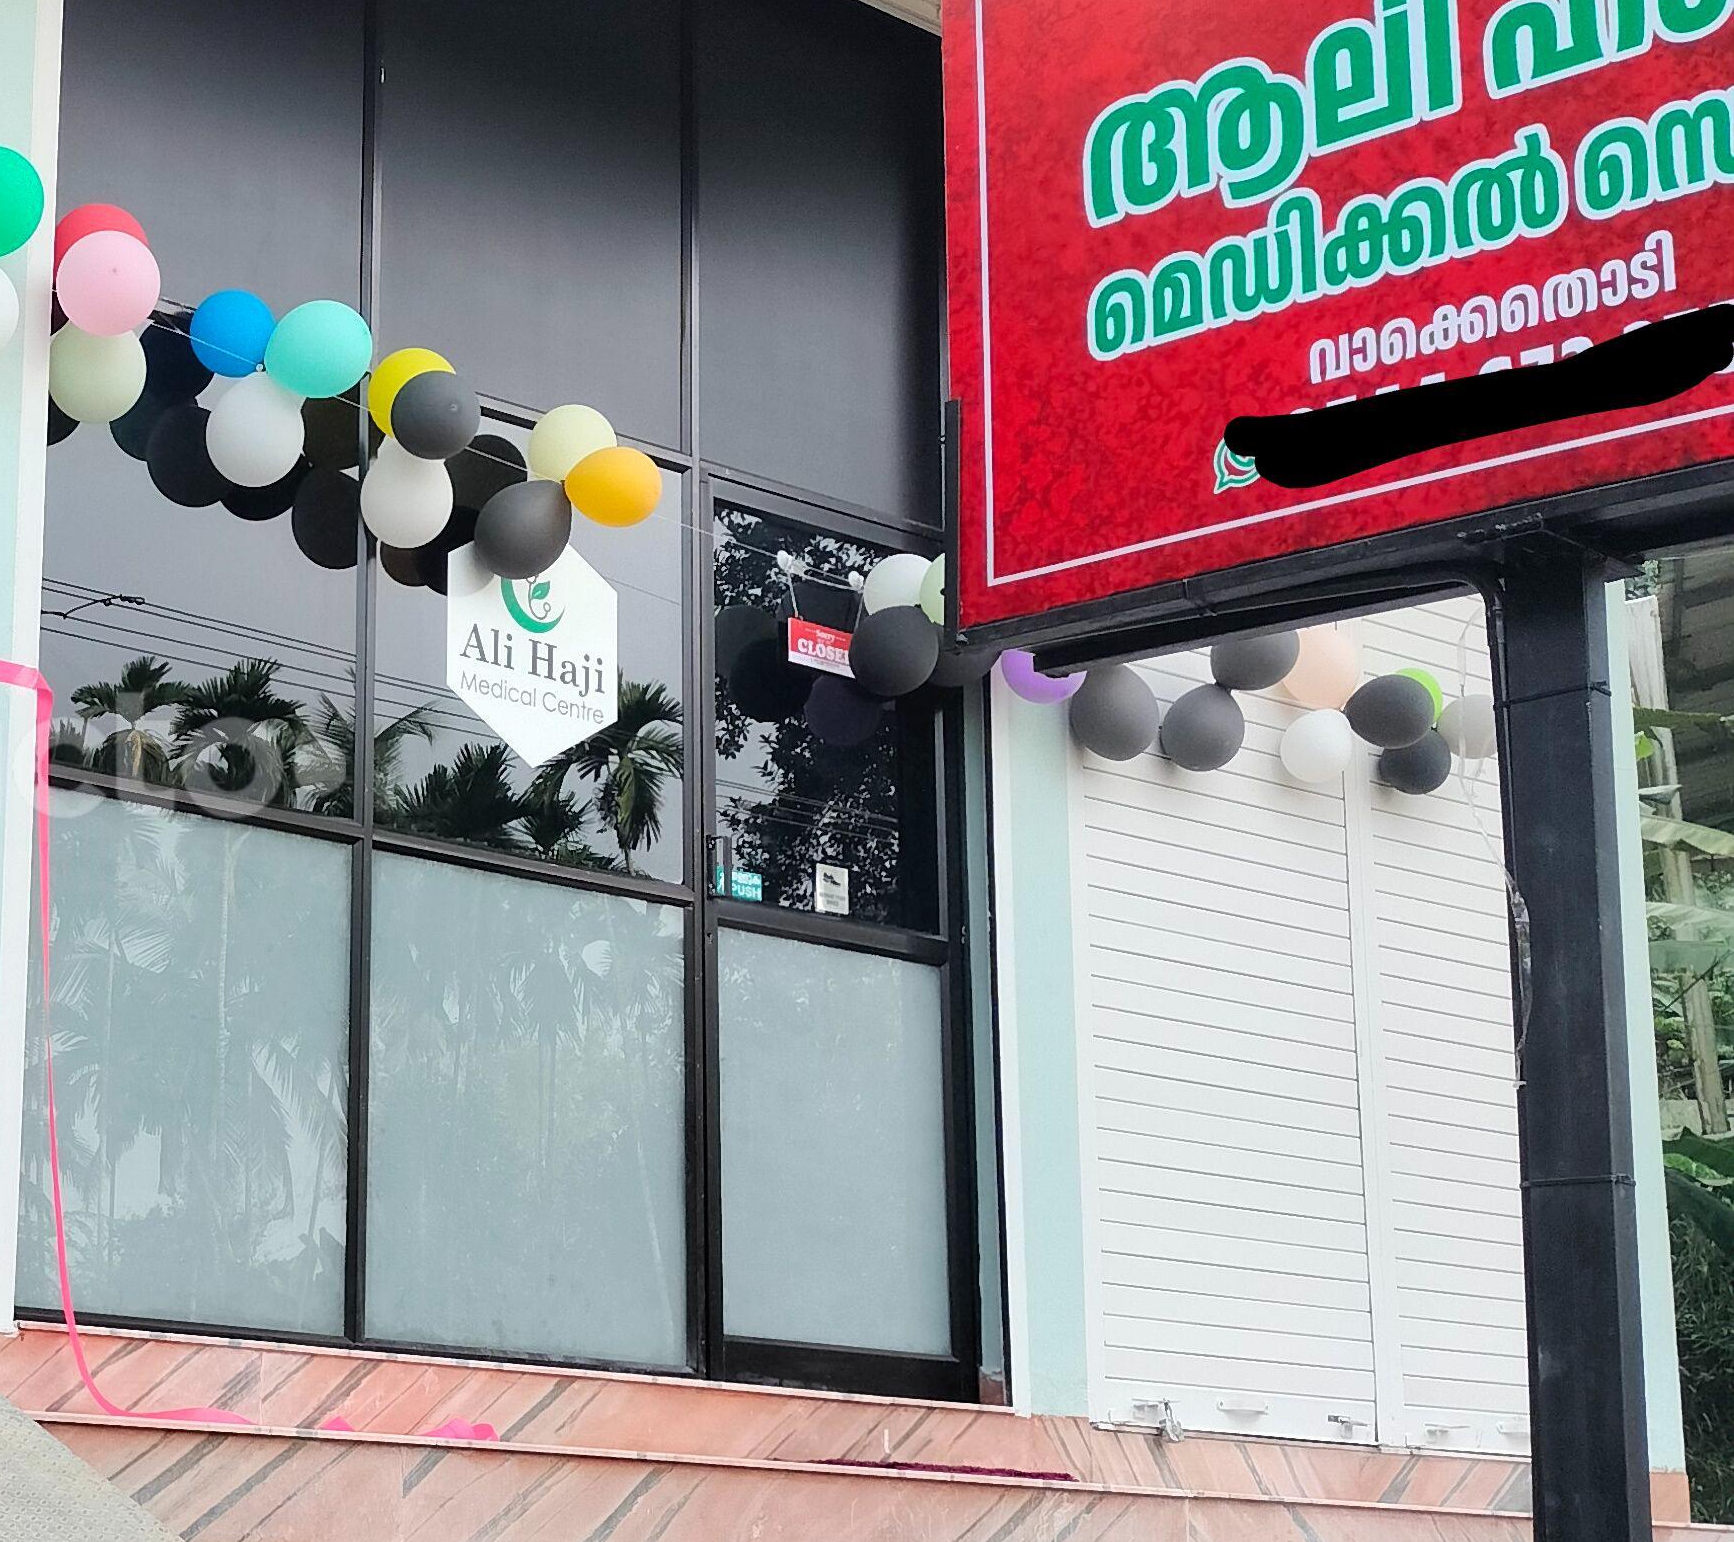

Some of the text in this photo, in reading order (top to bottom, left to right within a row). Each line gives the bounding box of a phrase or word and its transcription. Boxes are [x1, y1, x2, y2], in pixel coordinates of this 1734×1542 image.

[1087, 123, 1568, 362] മെഡിക്കൽ
[459, 623, 606, 698] Ali Haji
[460, 671, 605, 725] Medical Centre
